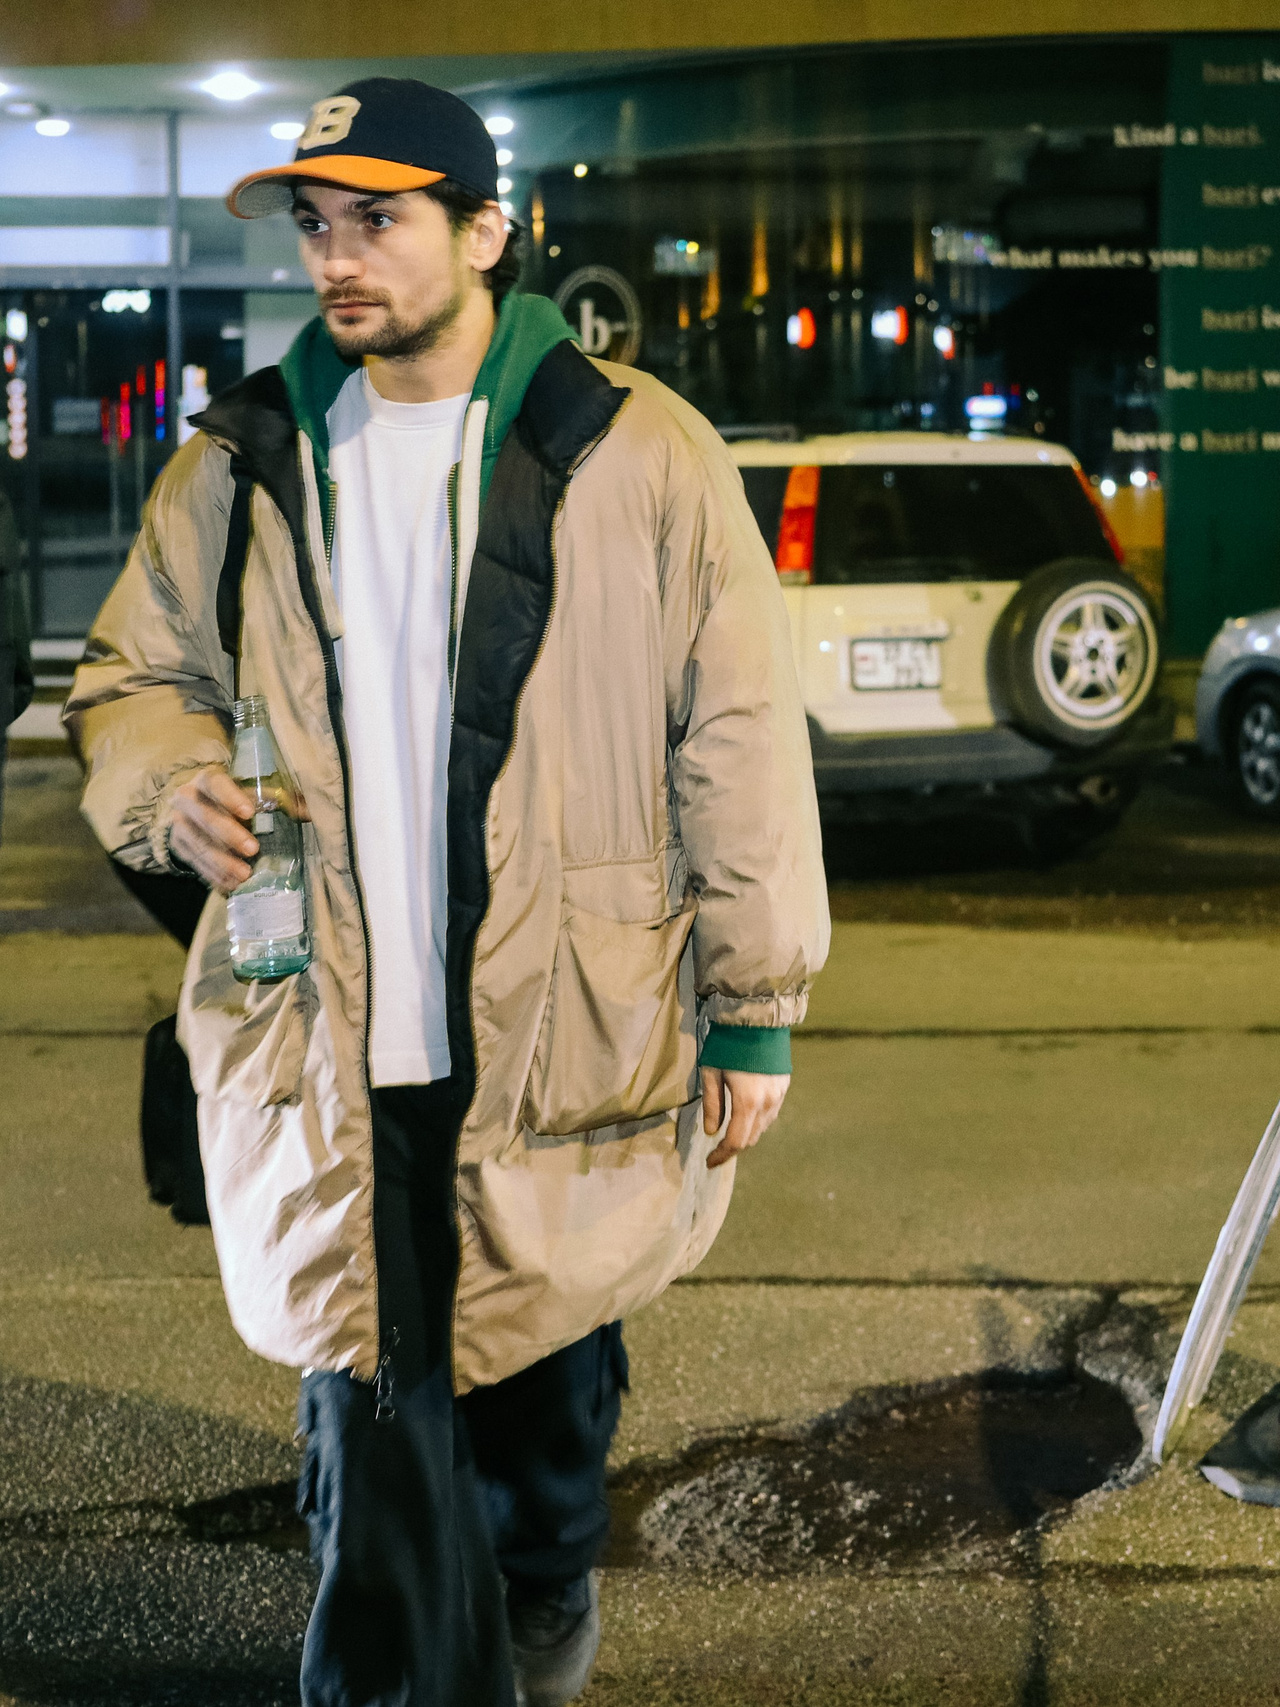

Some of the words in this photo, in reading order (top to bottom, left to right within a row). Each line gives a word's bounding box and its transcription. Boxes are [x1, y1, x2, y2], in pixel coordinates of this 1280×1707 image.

[298, 95, 362, 150] B
[1180, 126, 1198, 146] a
[989, 246, 1053, 270] what
[1057, 245, 1147, 270] makes
[1148, 249, 1198, 274] you
[580, 298, 611, 355] b
[1163, 367, 1198, 390] be
[1112, 427, 1176, 452] have
[1179, 431, 1198, 452] a
